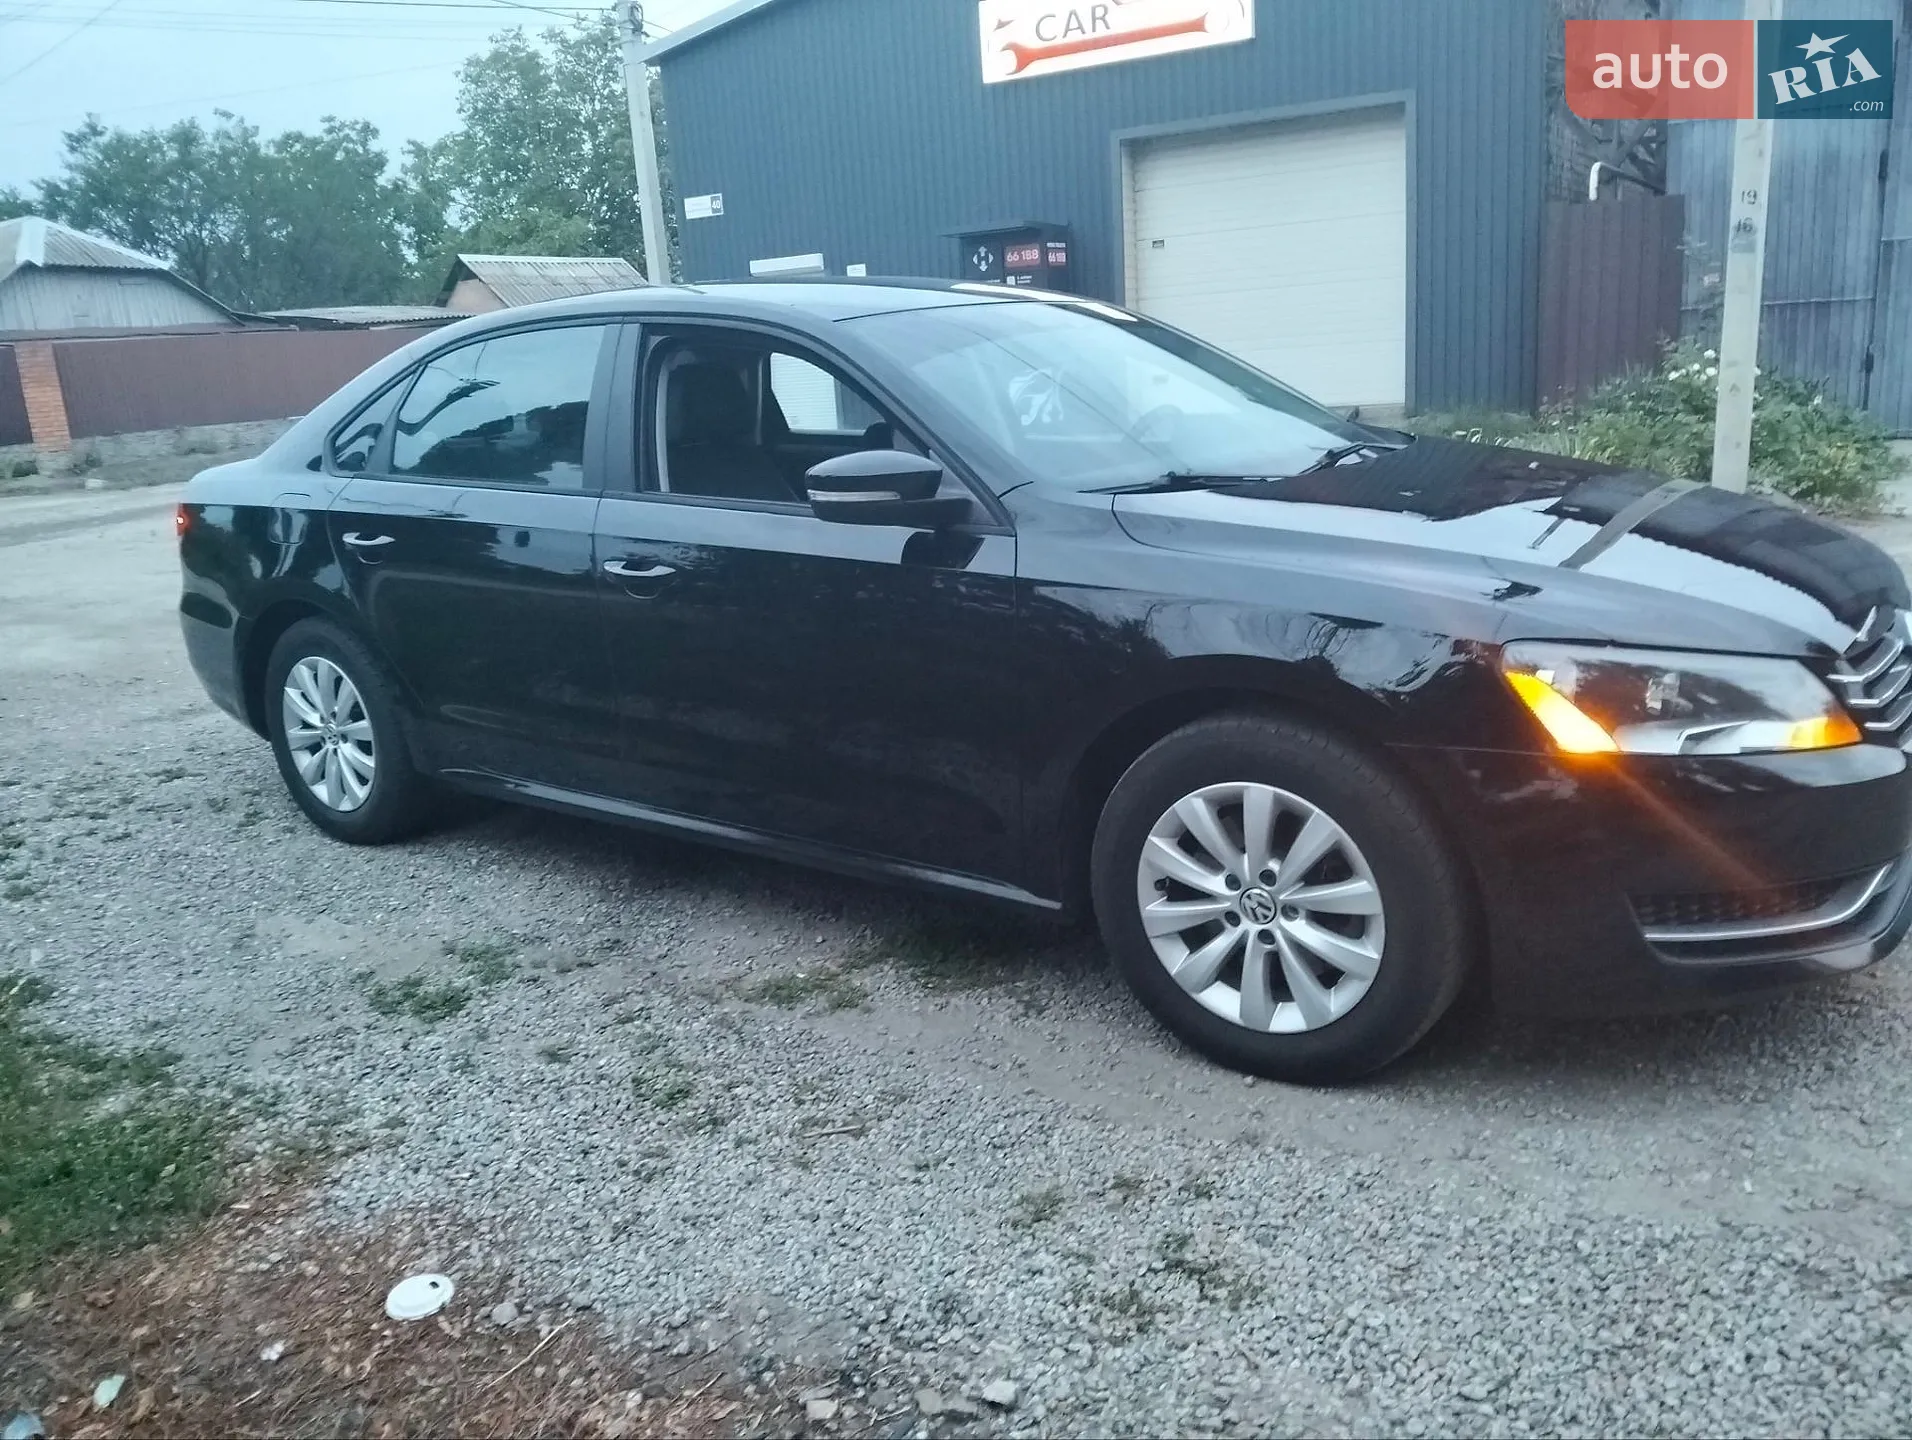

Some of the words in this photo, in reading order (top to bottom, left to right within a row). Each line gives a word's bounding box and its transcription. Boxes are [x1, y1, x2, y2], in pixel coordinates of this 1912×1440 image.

[1035, 4, 1111, 42] CAR
[712, 200, 721, 209] 40
[1741, 190, 1757, 205] 19
